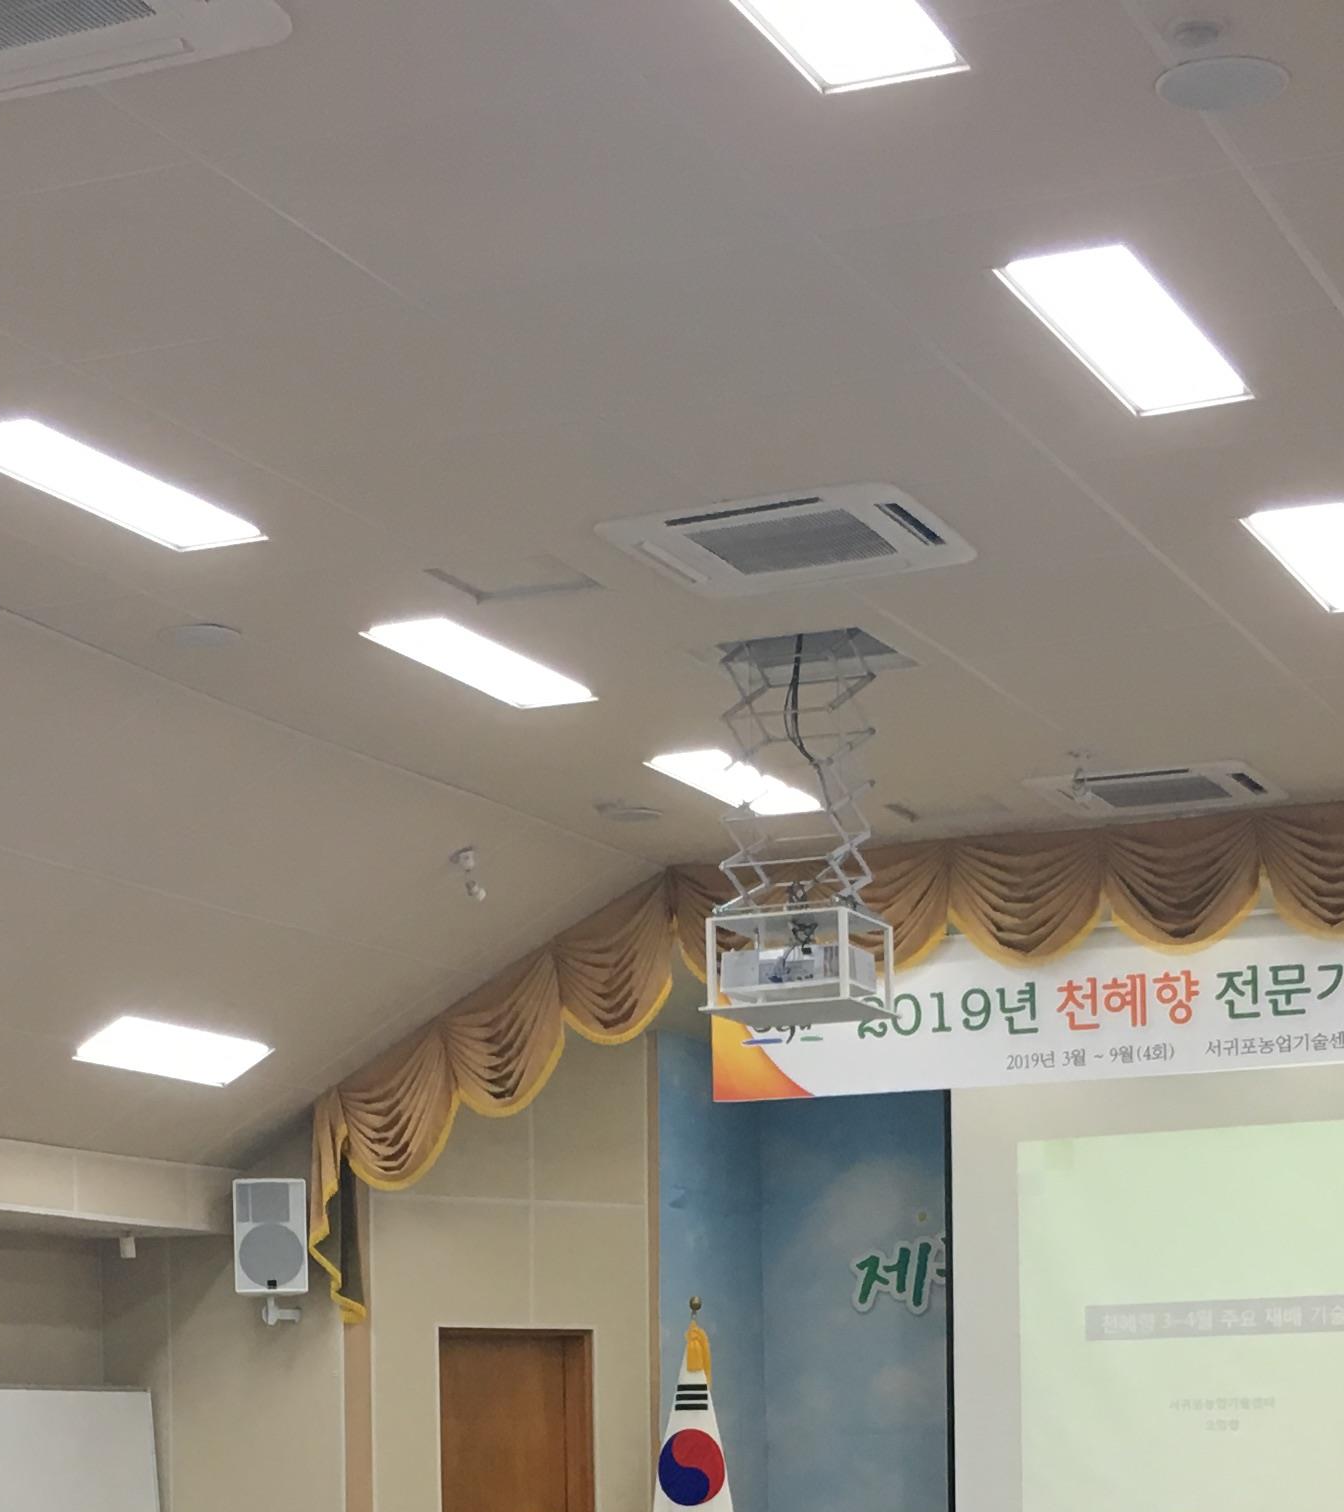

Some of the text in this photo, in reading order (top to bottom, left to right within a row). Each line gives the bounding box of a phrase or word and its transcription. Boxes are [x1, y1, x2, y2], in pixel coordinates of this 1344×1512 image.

[857, 982, 1039, 1039] 2019년
[1056, 970, 1200, 1031] 천혜향
[1006, 1051, 1055, 1070] 2019년
[1062, 1049, 1086, 1067] 3월
[1109, 1042, 1175, 1064] 9월(4회)
[856, 1239, 946, 1307] 제
[1264, 1305, 1302, 1328] 재배
